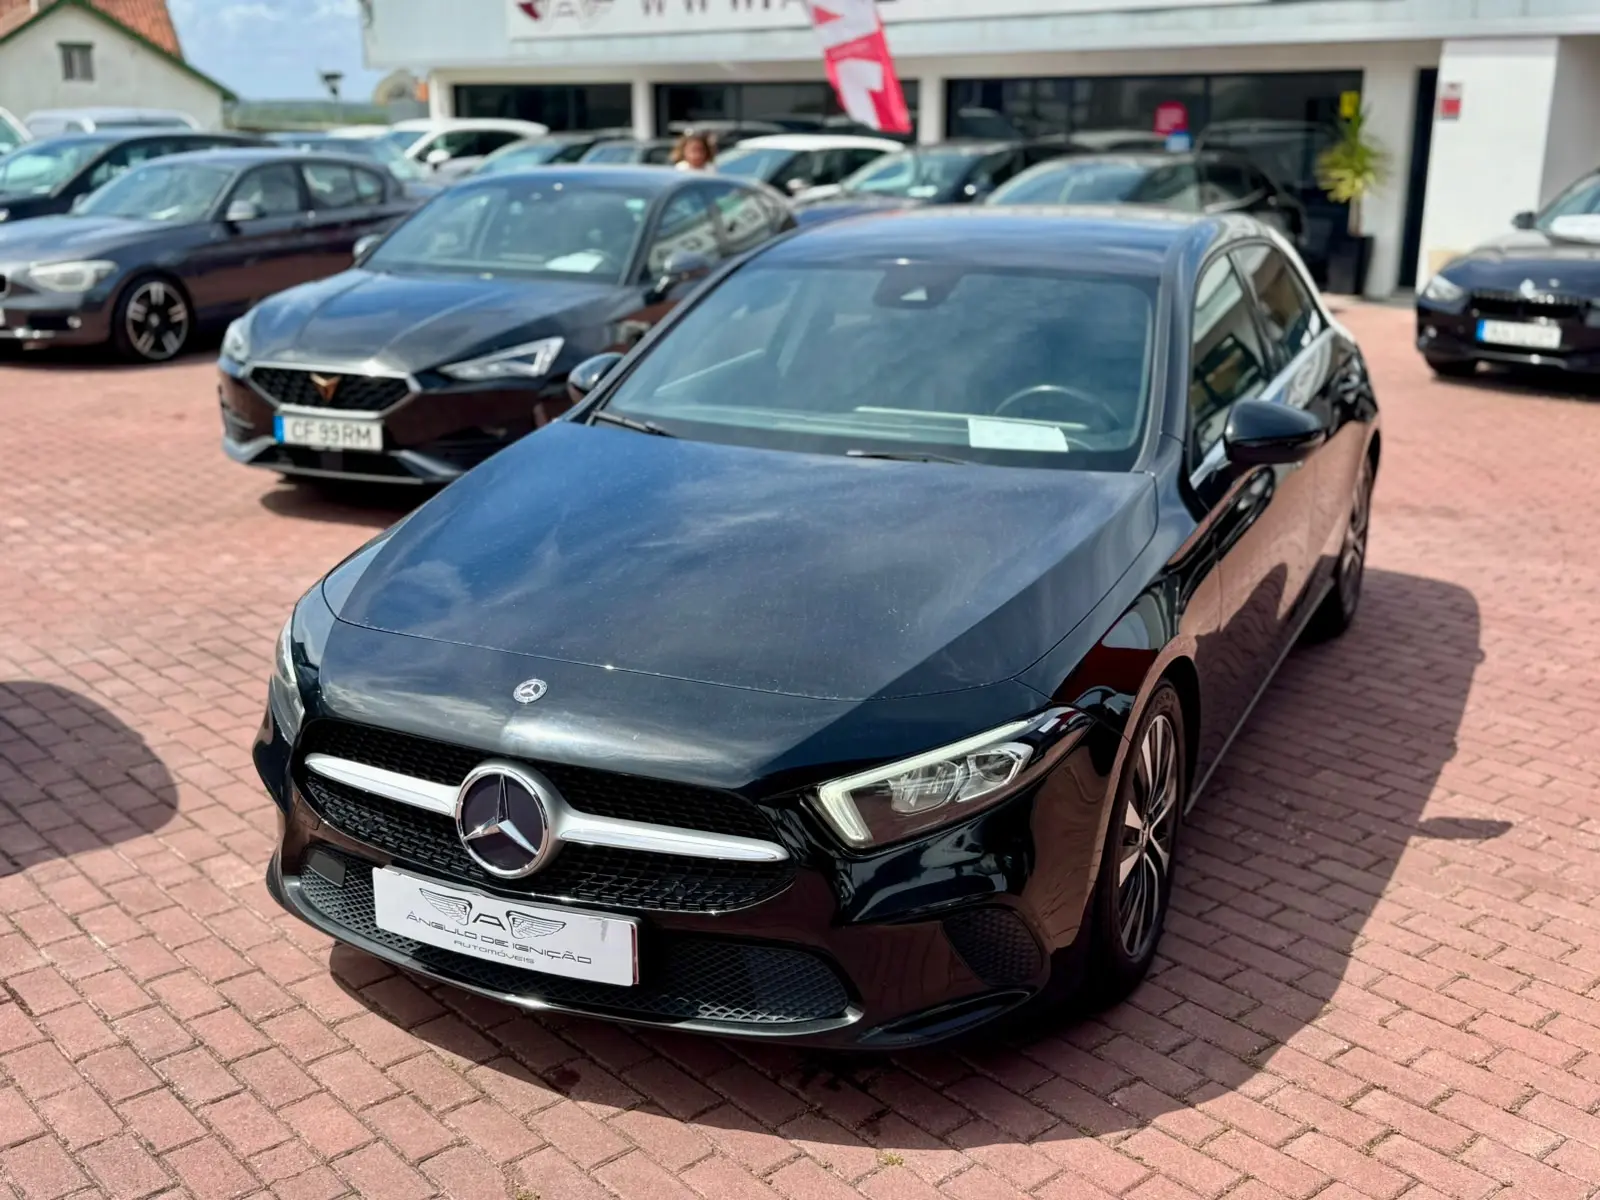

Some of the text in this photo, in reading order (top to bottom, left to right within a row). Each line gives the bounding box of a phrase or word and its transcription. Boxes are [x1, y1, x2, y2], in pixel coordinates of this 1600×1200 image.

[406, 910, 592, 965] ÂNGULO DE IGNIÇÃO
